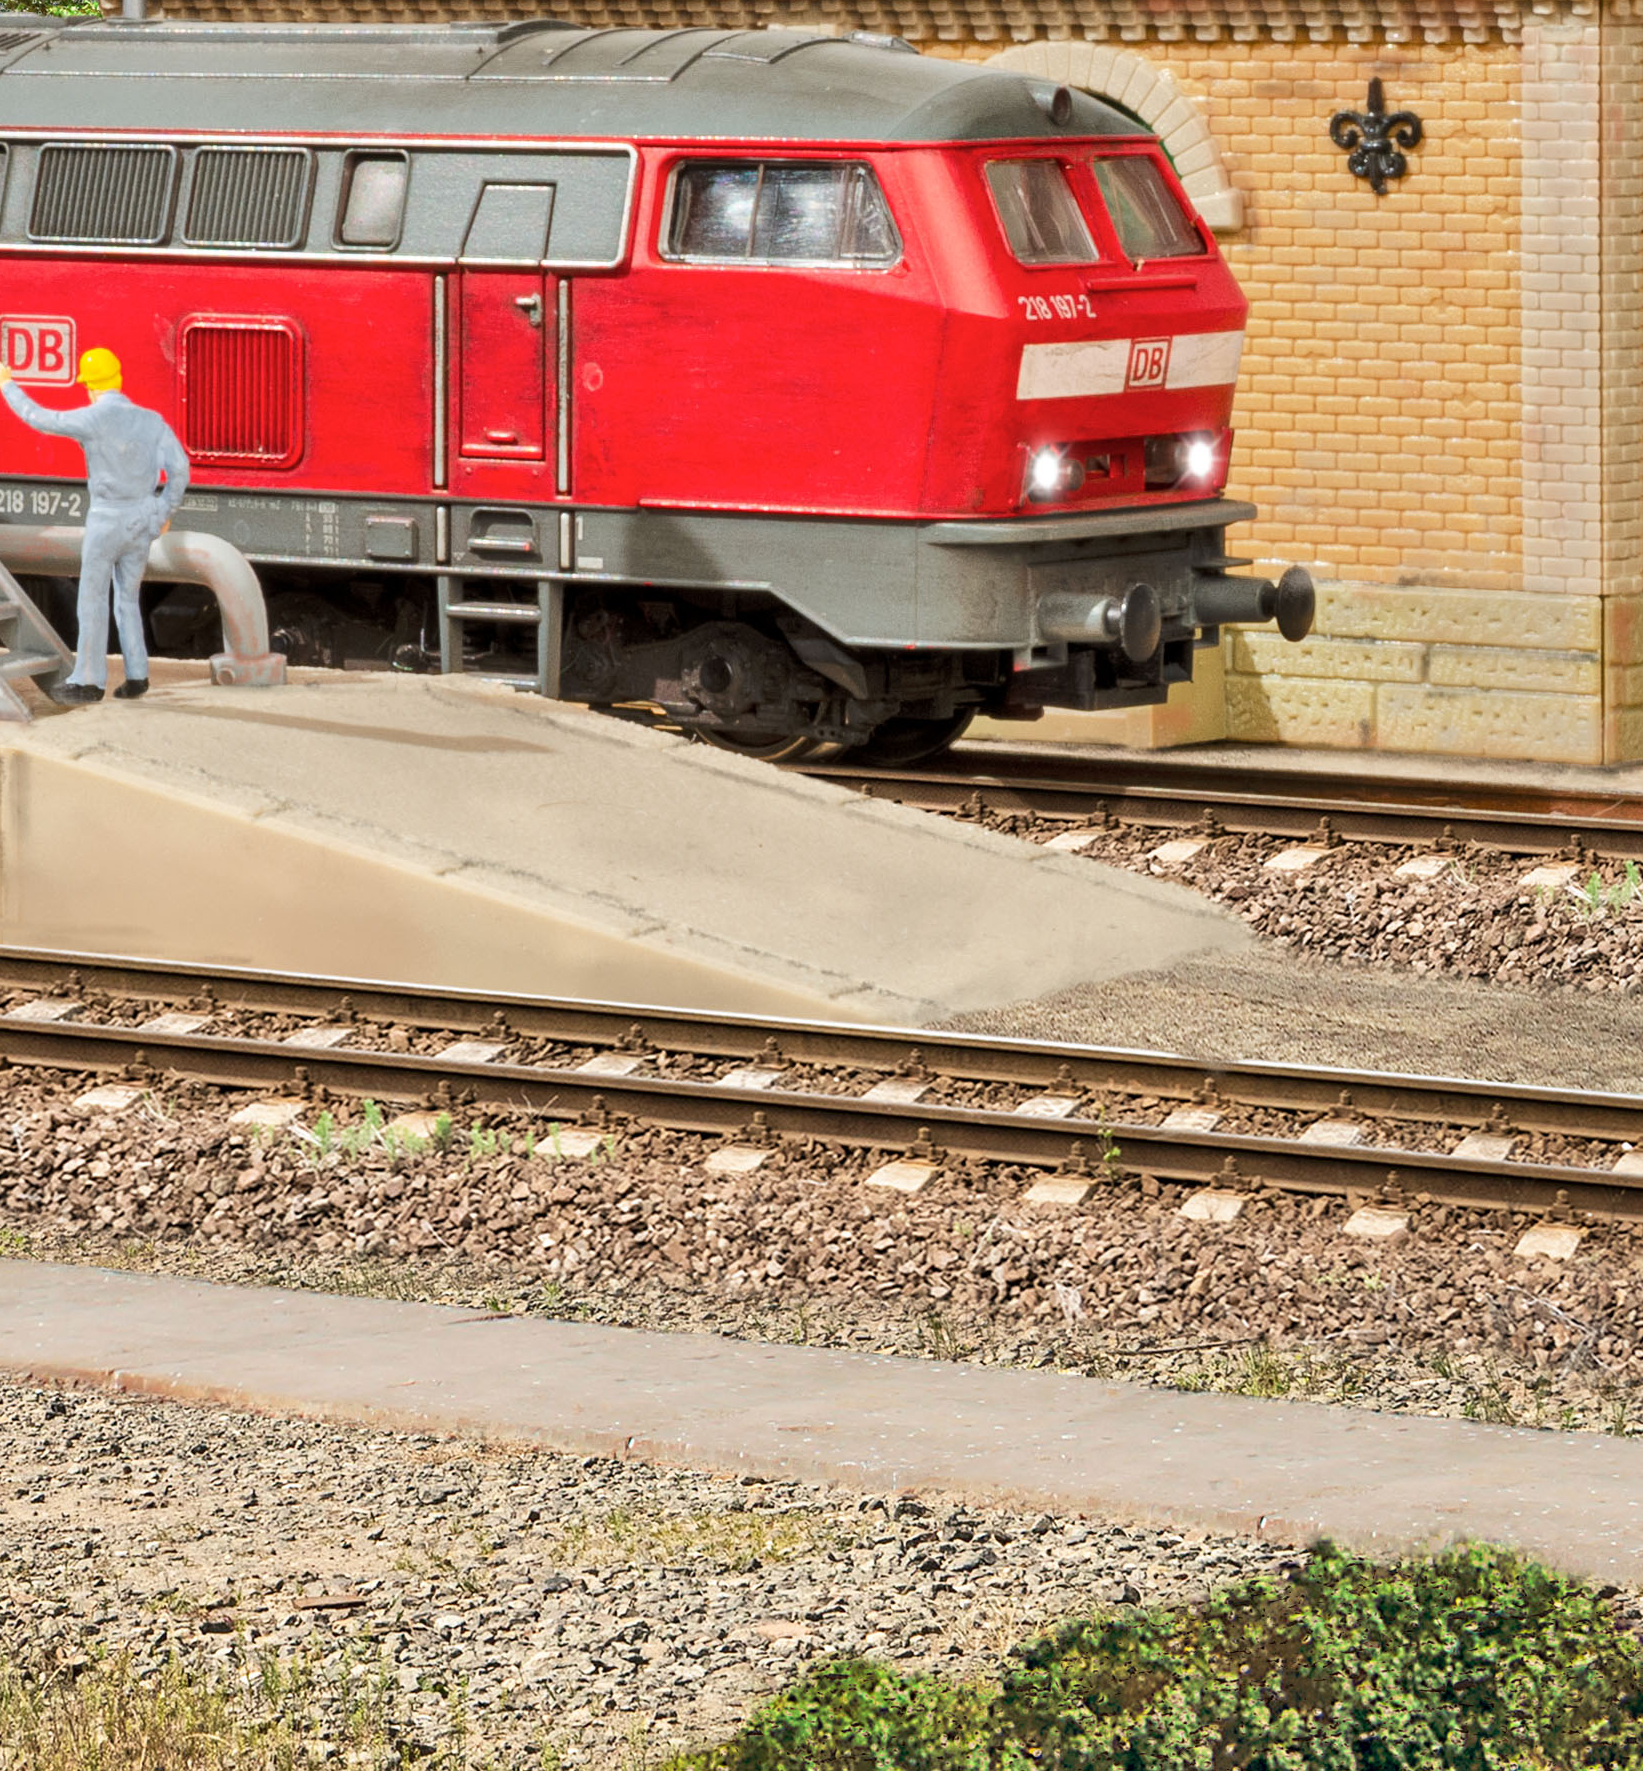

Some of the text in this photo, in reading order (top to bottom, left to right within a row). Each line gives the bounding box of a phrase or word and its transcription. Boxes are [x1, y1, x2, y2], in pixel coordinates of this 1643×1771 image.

[1018, 294, 1097, 320] 218 197-2
[7, 327, 64, 372] DB
[1132, 347, 1164, 382] DB
[30, 491, 82, 517] 197-2
